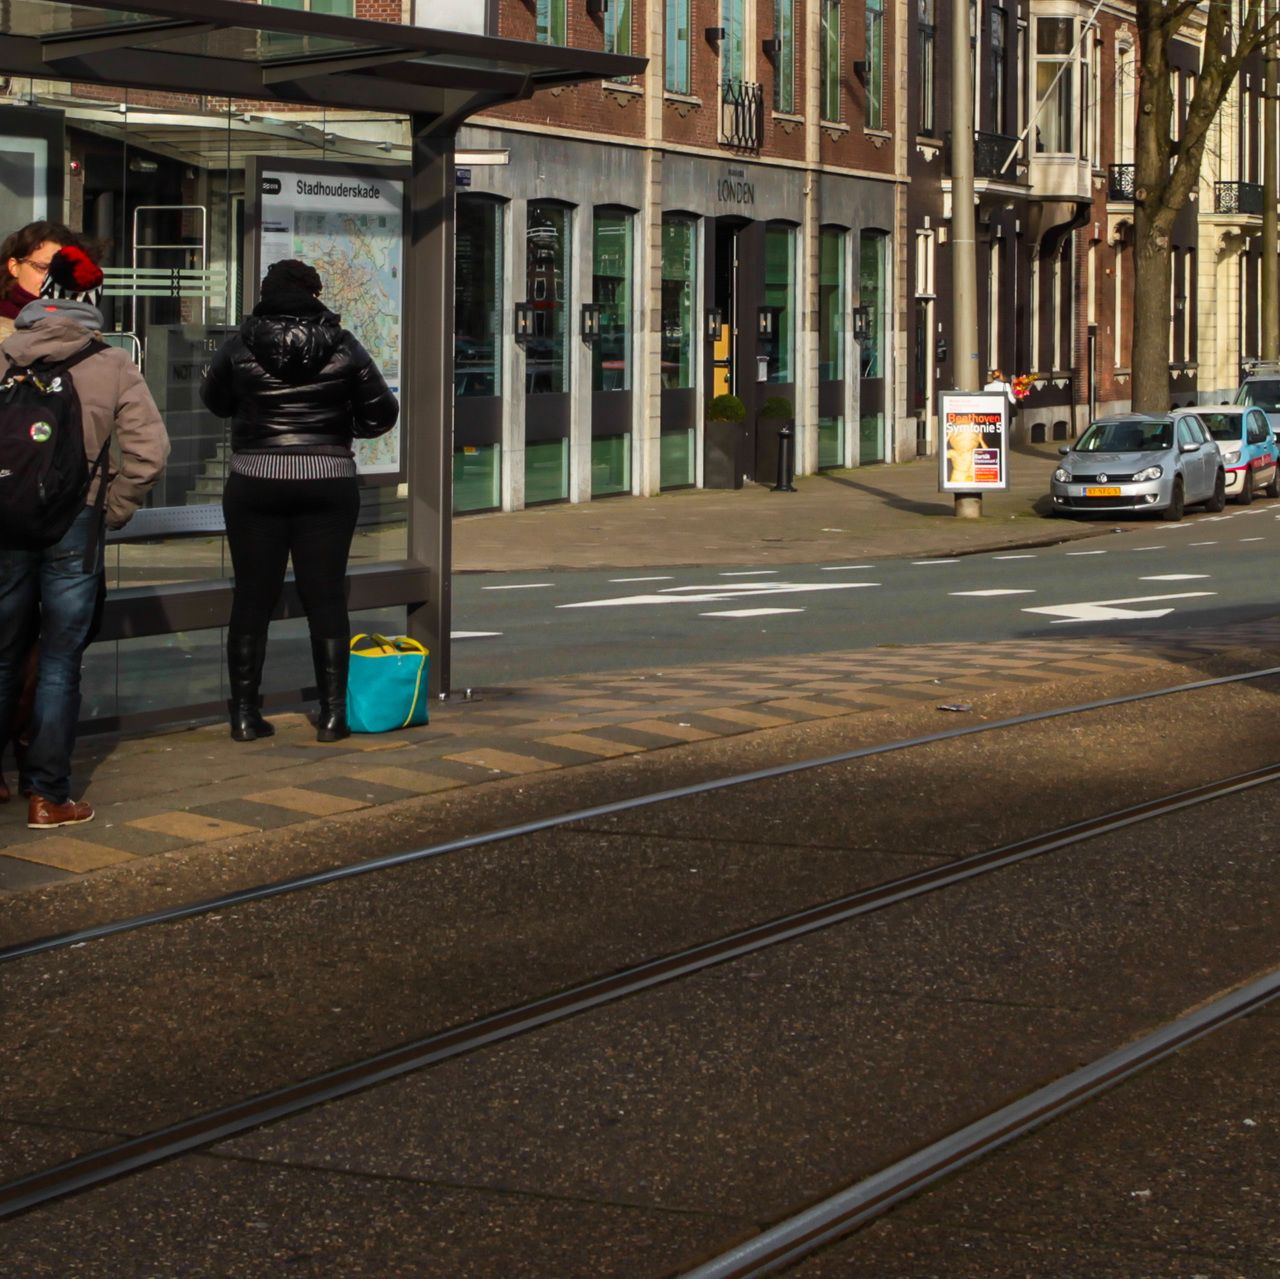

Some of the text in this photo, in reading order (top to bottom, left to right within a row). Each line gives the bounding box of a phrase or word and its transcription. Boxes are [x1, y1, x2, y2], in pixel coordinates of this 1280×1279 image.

[296, 179, 381, 199] Stadhouderskade
[718, 179, 754, 204] LONDEN
[947, 412, 1001, 423] Beethoven
[946, 422, 1002, 433] Symfonie 5
